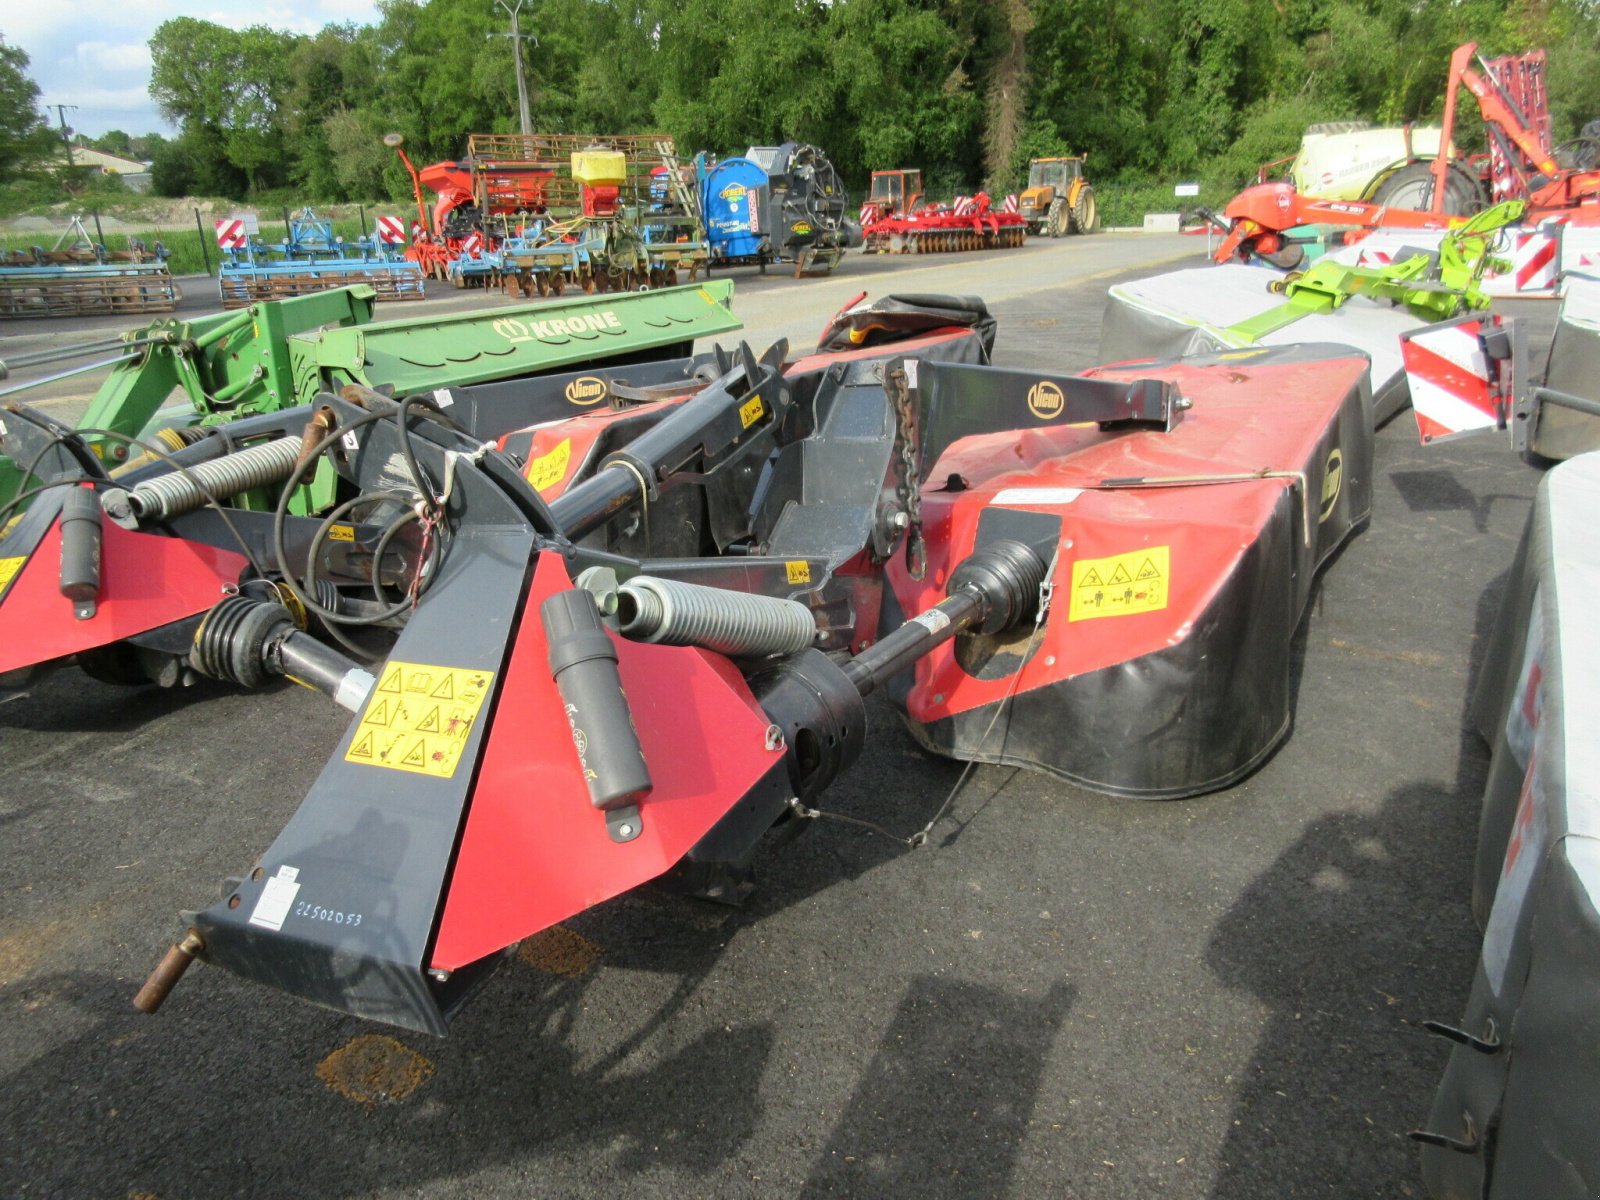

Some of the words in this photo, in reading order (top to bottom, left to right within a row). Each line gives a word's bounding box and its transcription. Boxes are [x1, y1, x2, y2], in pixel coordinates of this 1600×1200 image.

[529, 311, 622, 338] KRONE
[569, 380, 602, 400] Vicon
[1031, 383, 1061, 411] Vicon
